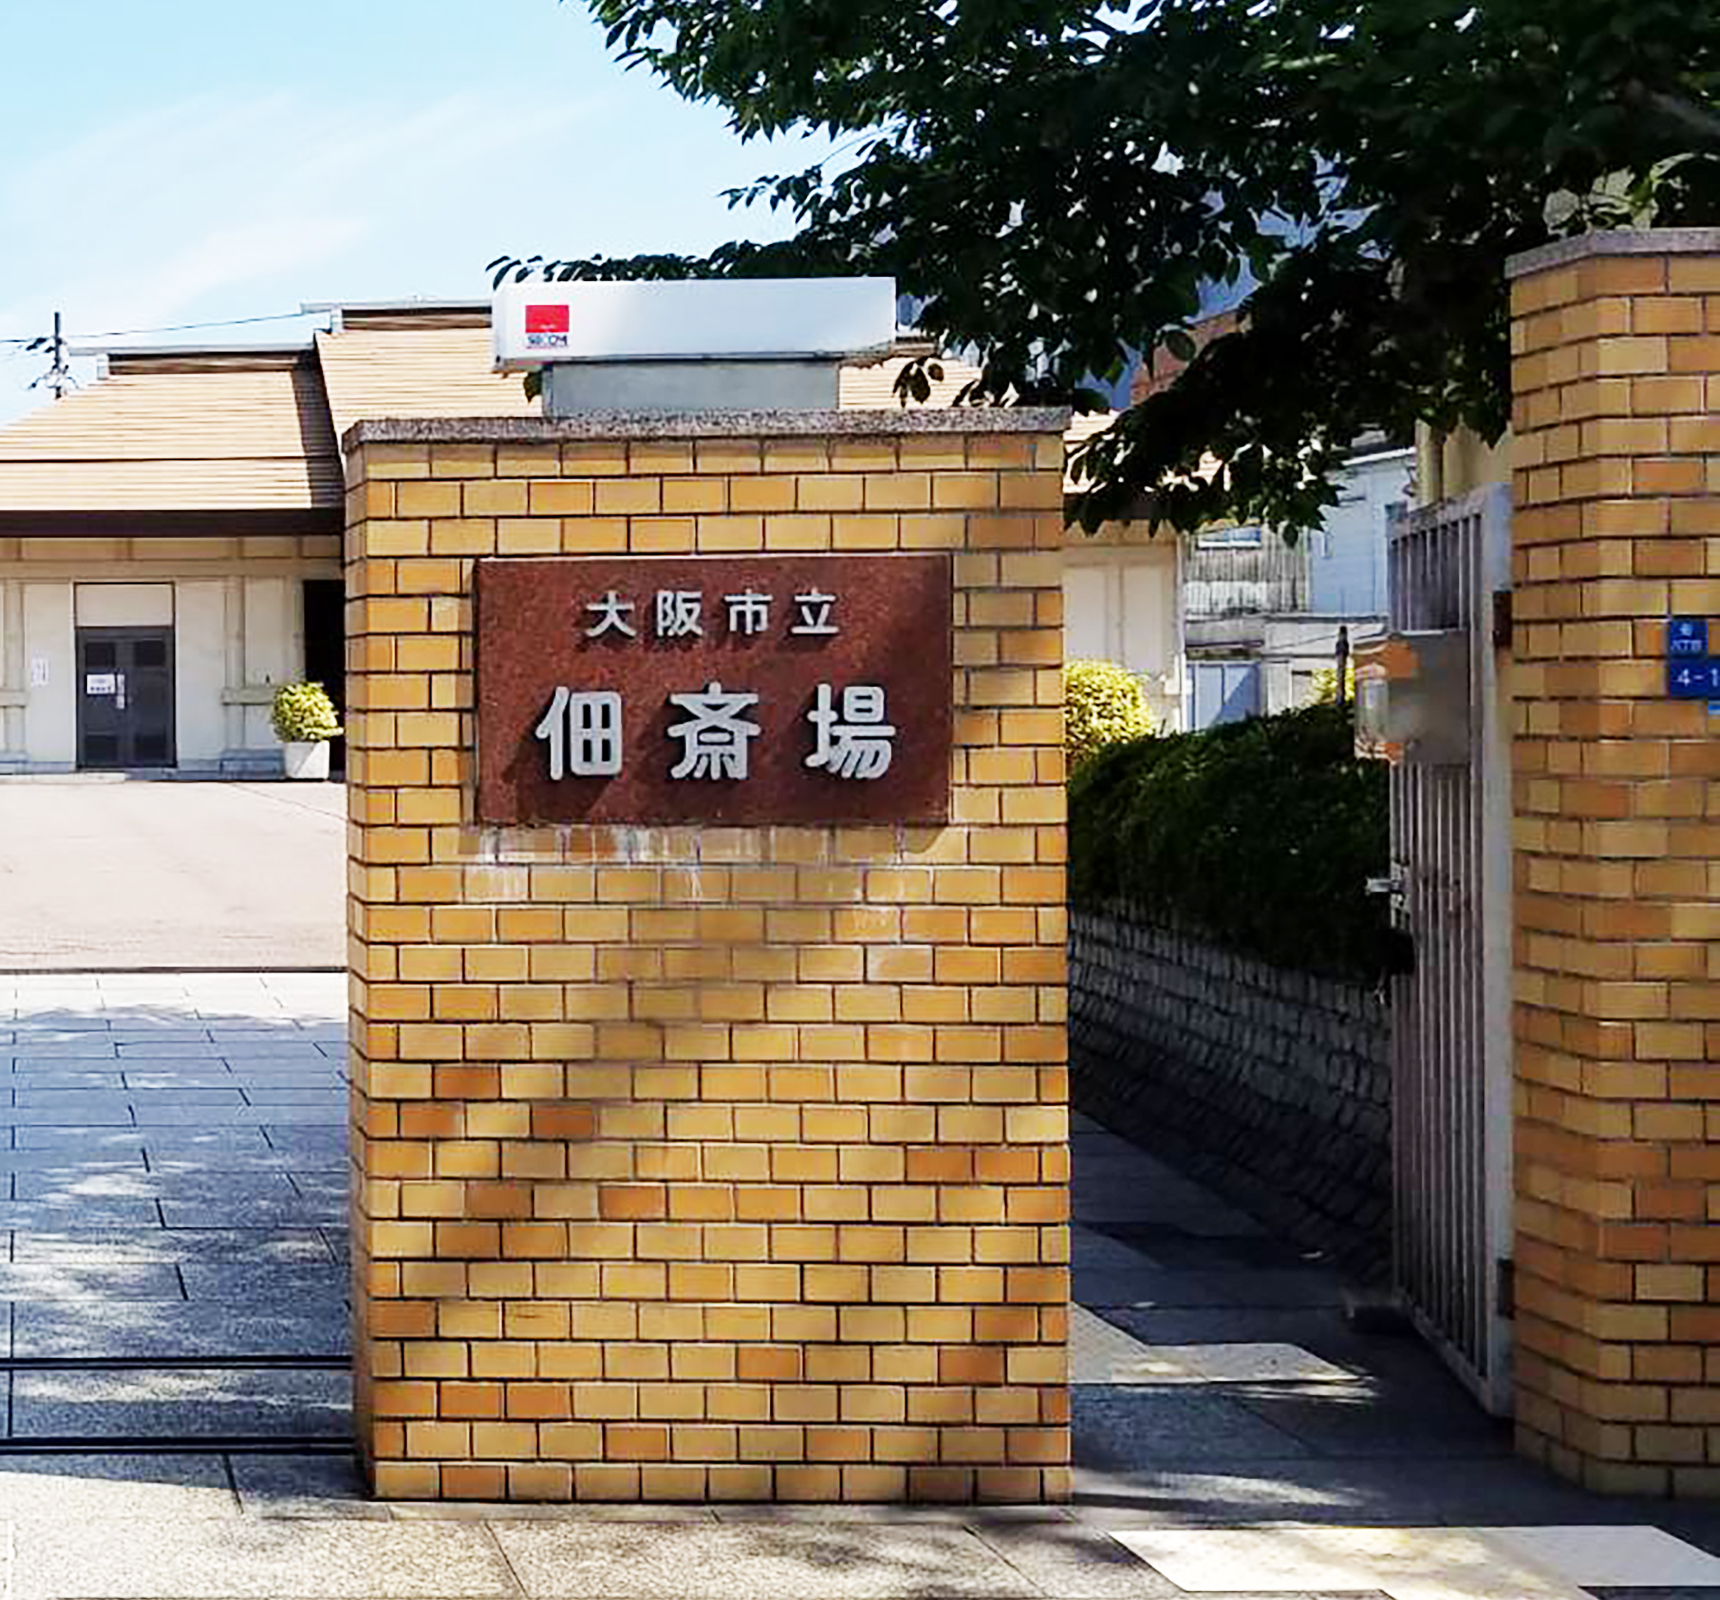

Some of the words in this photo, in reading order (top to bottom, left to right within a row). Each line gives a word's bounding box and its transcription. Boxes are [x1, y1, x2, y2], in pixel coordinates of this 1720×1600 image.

[585, 587, 840, 638] 大阪市立
[536, 681, 897, 780] 佃斎場
